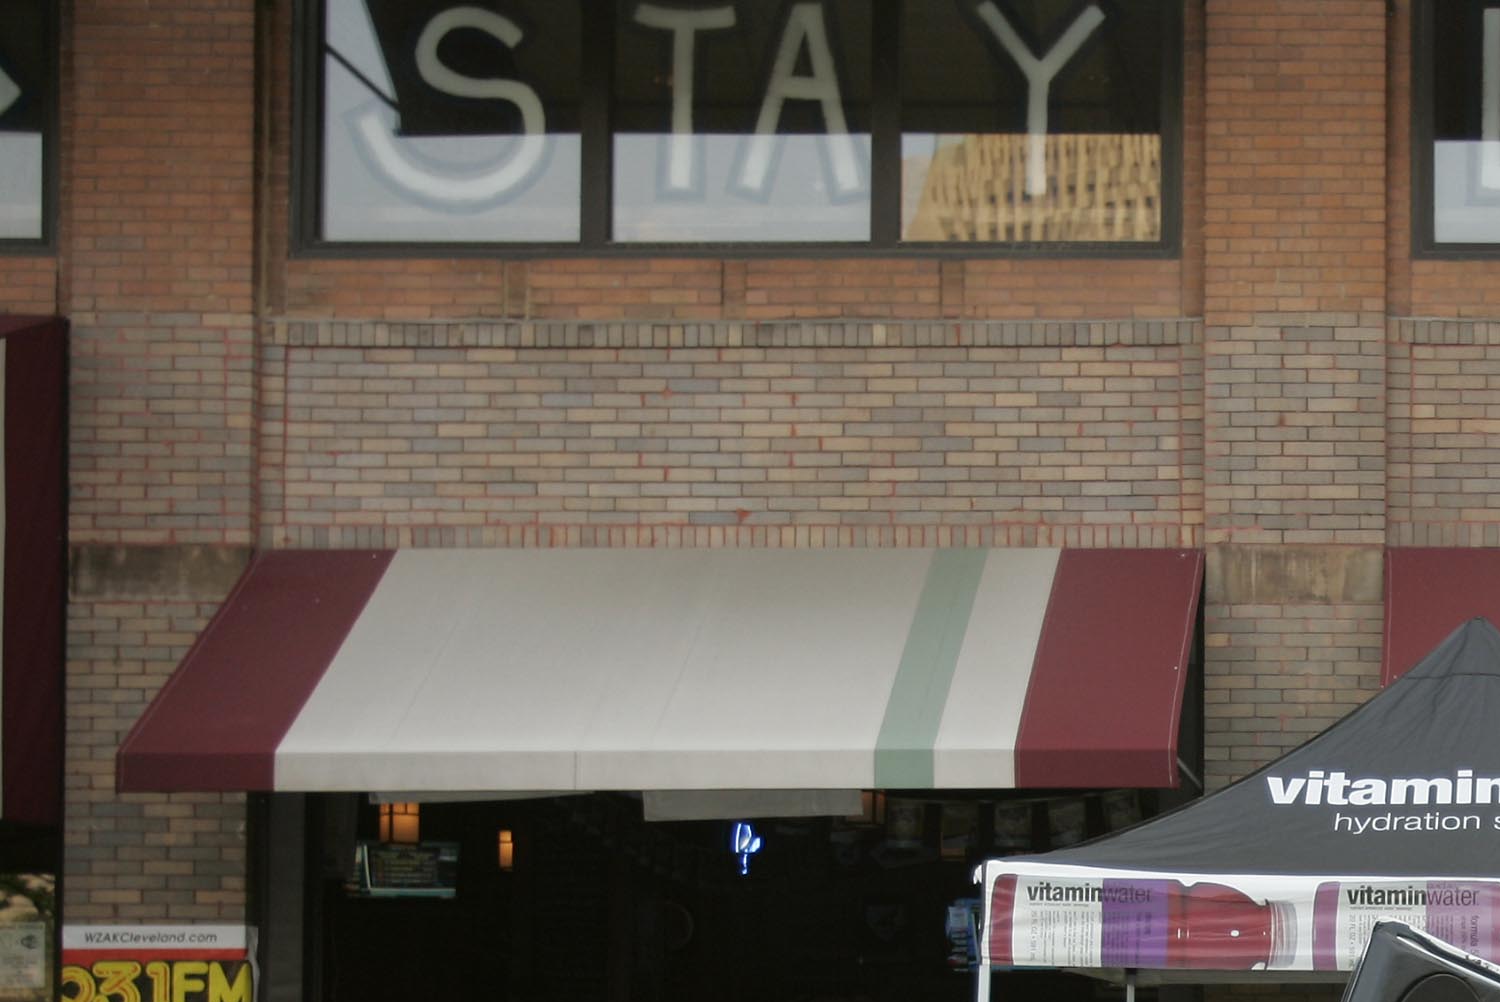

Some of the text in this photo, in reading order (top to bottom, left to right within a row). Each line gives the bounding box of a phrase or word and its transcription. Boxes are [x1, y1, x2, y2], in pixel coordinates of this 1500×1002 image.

[358, 0, 1105, 200] STAY
[1334, 811, 1481, 834] hydration
[1027, 882, 1152, 903] vitaminwater
[1347, 884, 1480, 906] vitaminwater
[84, 932, 218, 943] WZAKCleveland.com
